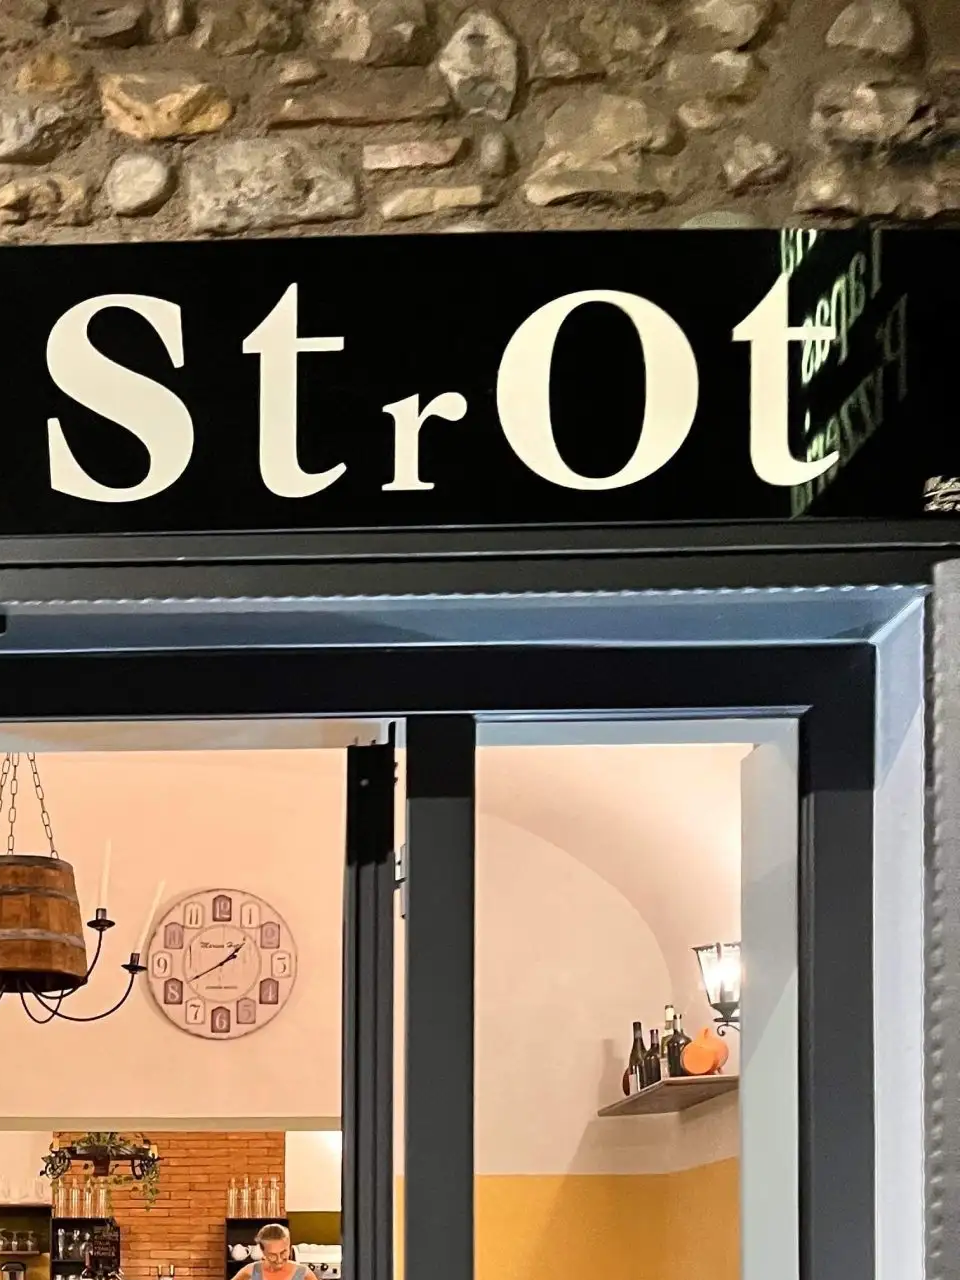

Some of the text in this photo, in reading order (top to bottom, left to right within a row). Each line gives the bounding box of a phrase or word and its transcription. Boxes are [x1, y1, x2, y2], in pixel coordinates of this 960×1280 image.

[157, 957, 168, 974] 9
[168, 984, 179, 1001] 8
[190, 1004, 200, 1021] 7
[242, 1004, 252, 1021] 5
[215, 1013, 227, 1030] 6
